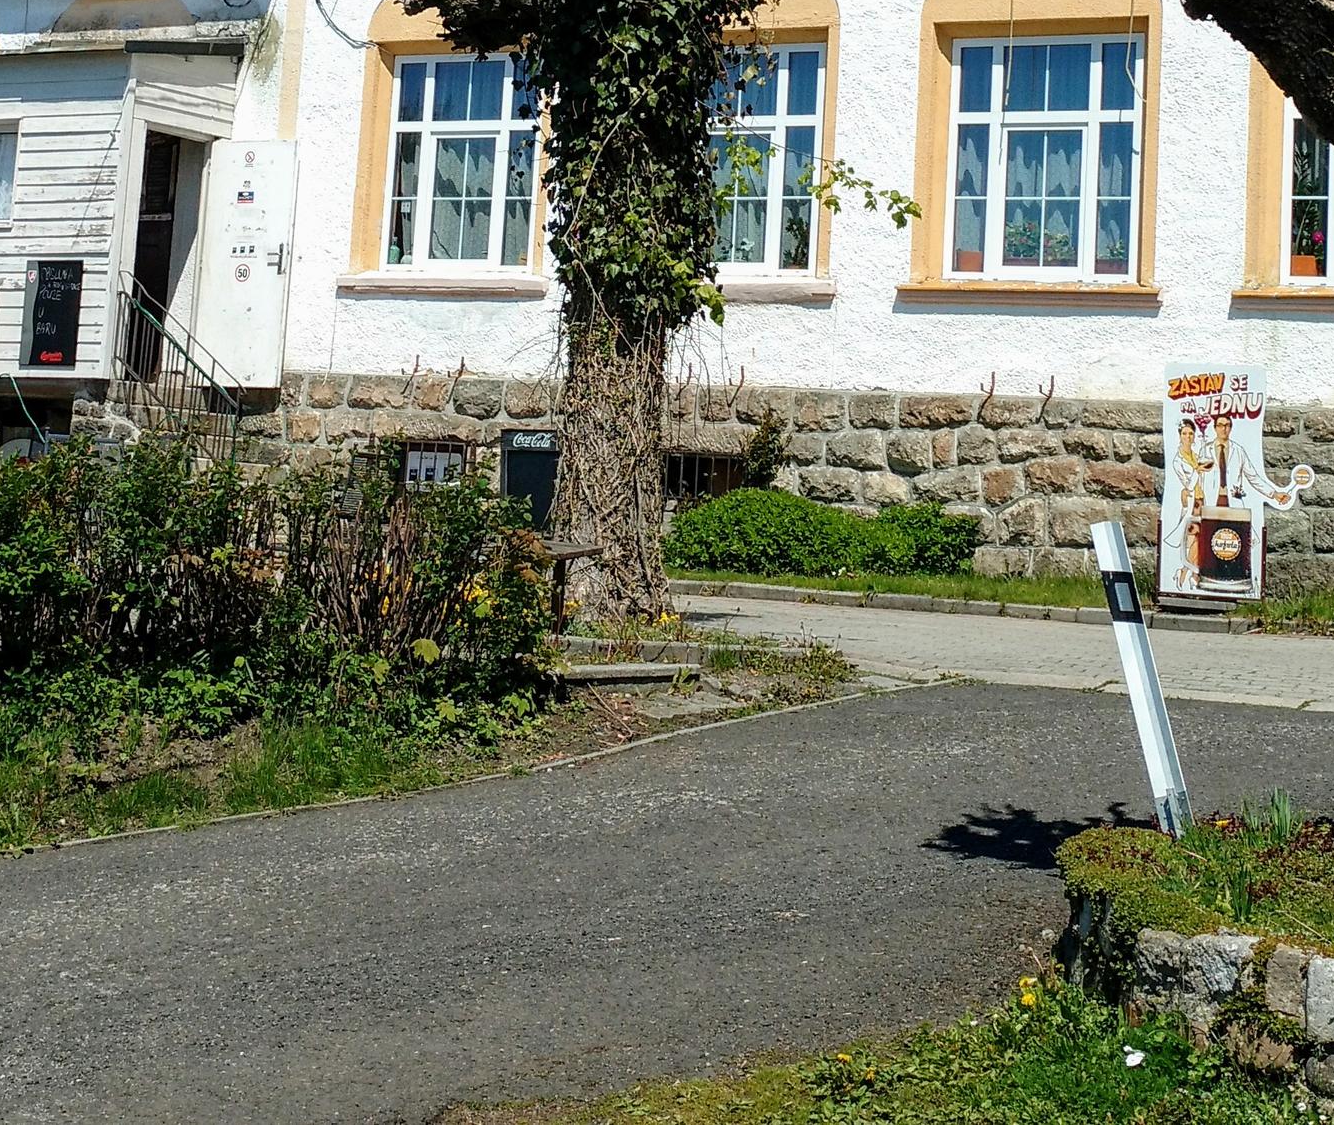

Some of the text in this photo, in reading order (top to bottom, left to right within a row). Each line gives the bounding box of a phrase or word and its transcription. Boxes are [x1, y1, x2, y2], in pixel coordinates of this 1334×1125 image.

[237, 268, 248, 279] 50
[1168, 372, 1248, 400] ZASTAV SE
[1180, 392, 1263, 420] NA JEDNU
